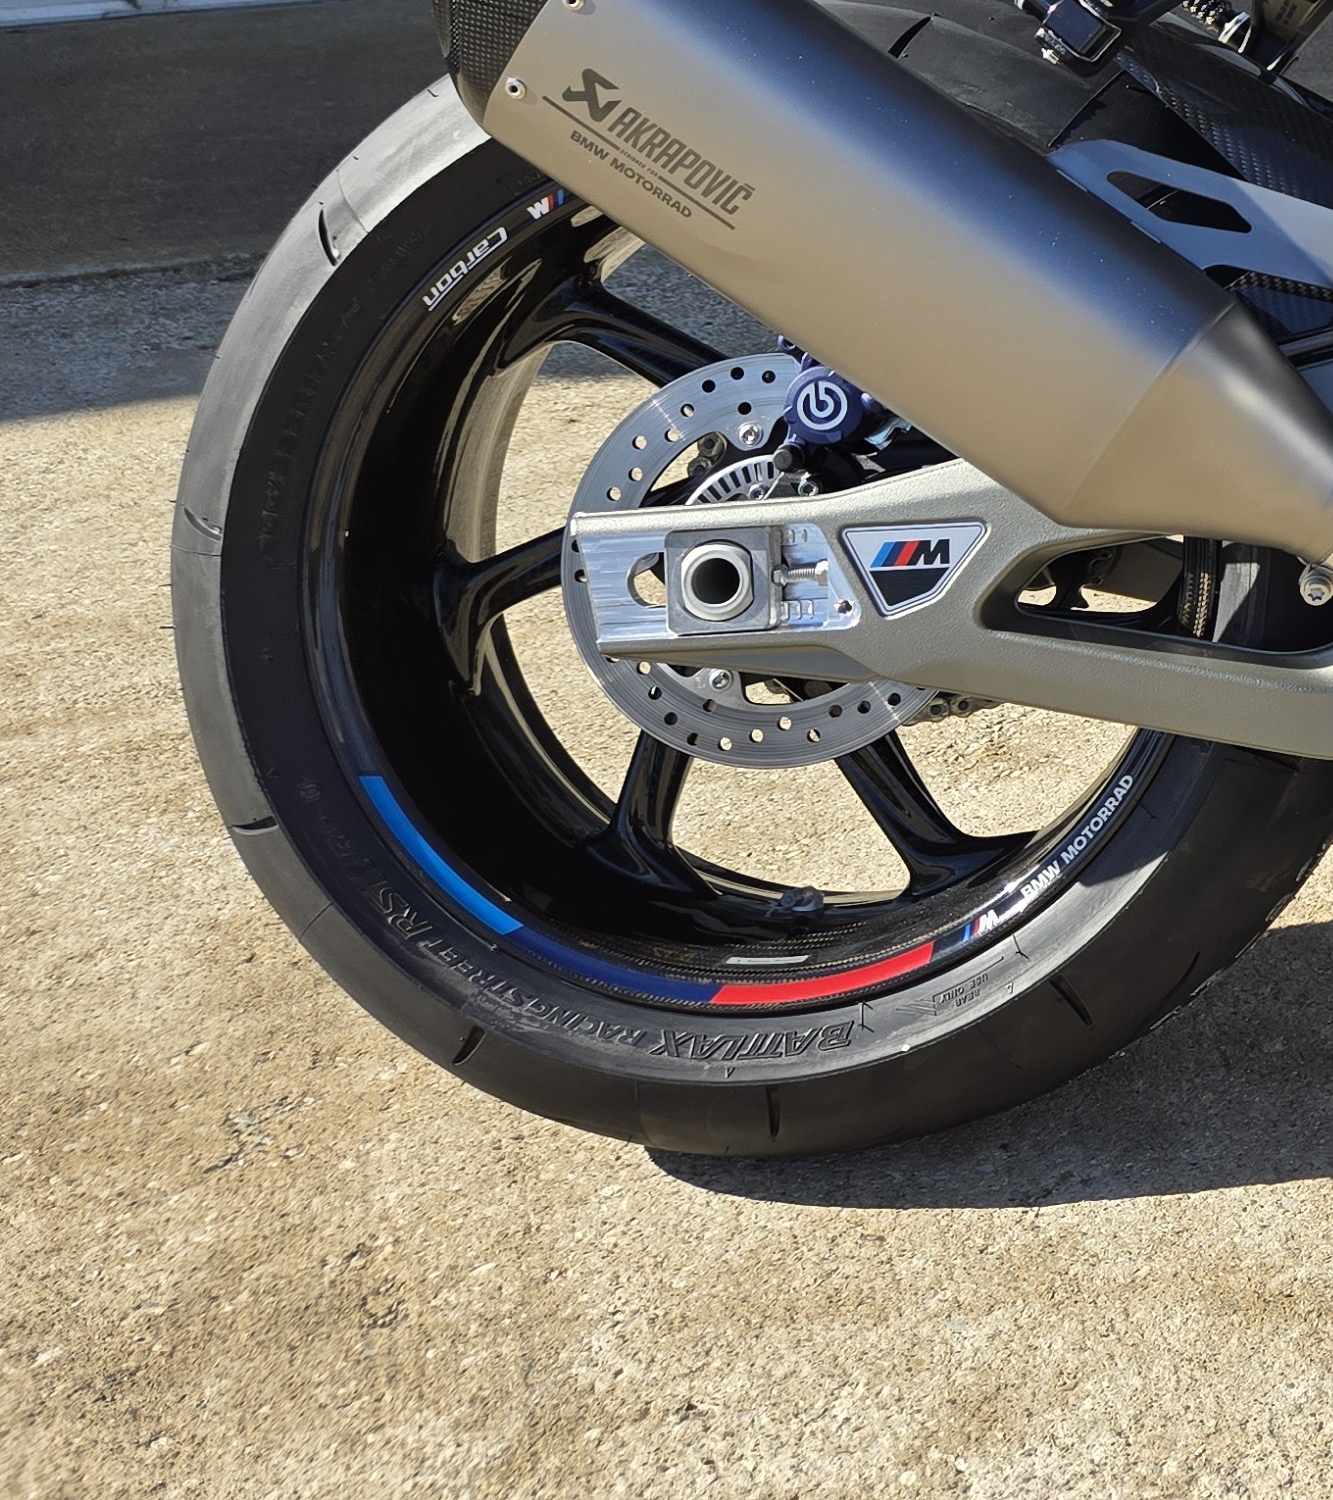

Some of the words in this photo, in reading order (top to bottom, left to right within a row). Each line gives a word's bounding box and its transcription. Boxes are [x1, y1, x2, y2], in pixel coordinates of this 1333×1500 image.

[570, 129, 610, 161] BMW
[609, 157, 693, 219] MOTORRAD
[422, 226, 508, 312] Carbon
[1020, 860, 1062, 901] BMW
[1060, 774, 1134, 866] MOTORRAD
[418, 936, 532, 1008] STREET
[528, 994, 648, 1049] RACING
[648, 1019, 856, 1060] BATTLAX
